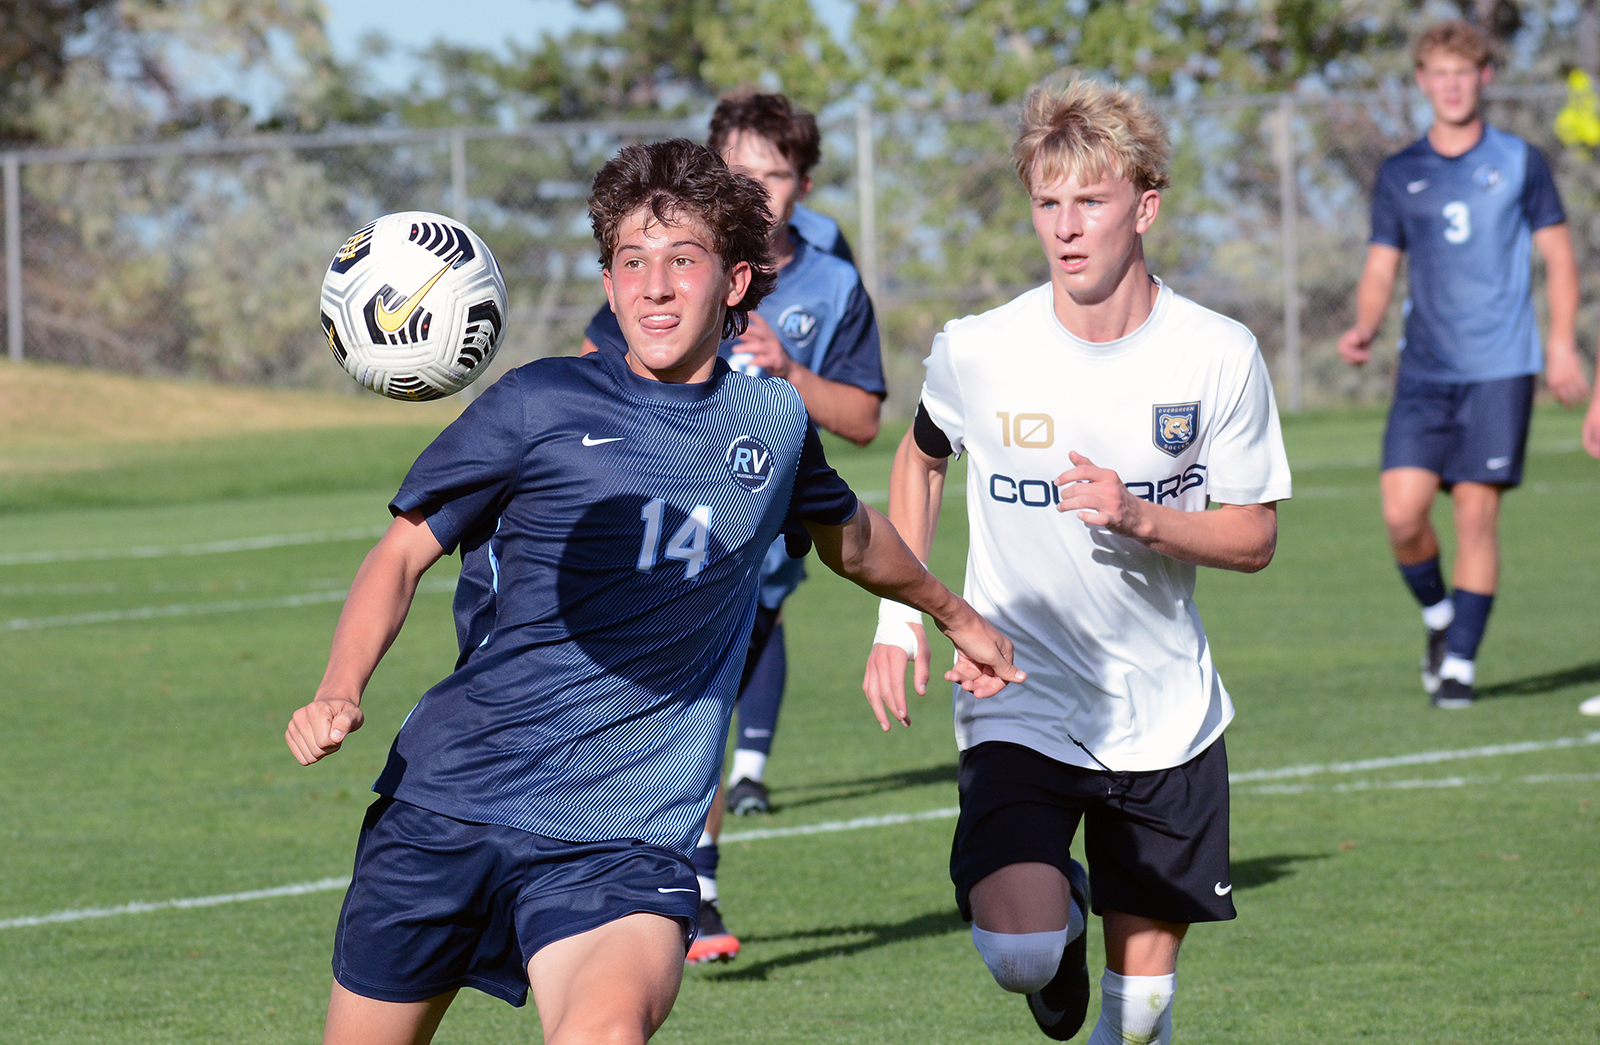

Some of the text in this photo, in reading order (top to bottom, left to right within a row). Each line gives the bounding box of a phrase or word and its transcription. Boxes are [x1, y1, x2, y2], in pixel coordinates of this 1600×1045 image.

[1442, 201, 1471, 244] 3
[784, 313, 816, 335] RV
[996, 411, 1055, 449] 10
[1164, 442, 1190, 450] SOCCER
[733, 447, 768, 474] RV
[636, 497, 713, 581] 14
